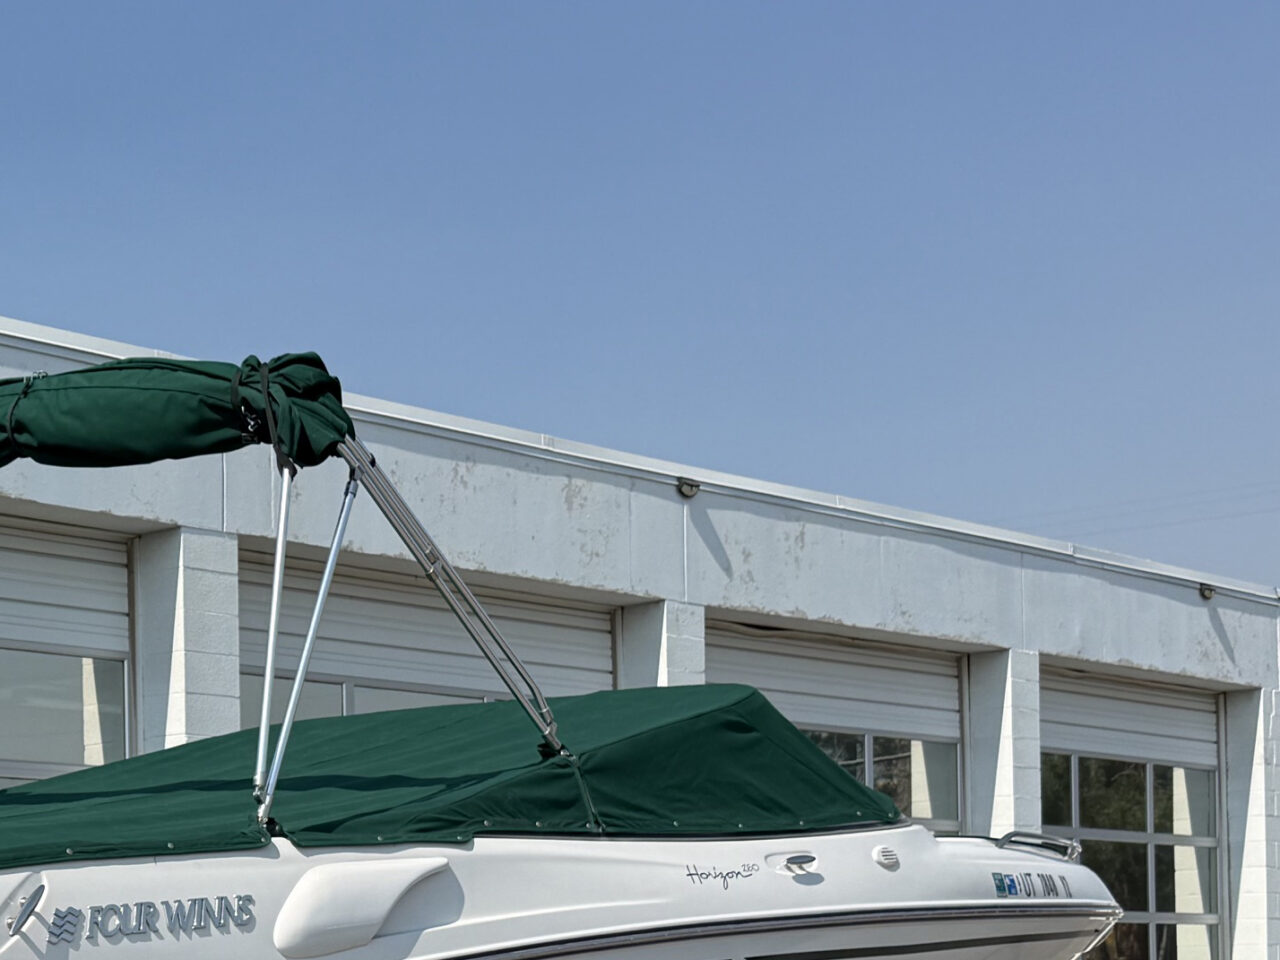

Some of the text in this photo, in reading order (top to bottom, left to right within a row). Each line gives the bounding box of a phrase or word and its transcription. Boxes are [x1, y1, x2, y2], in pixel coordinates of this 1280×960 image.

[686, 864, 753, 891] Horizon
[1019, 872, 1037, 898] UT
[85, 894, 256, 941] FOUR WINNS
